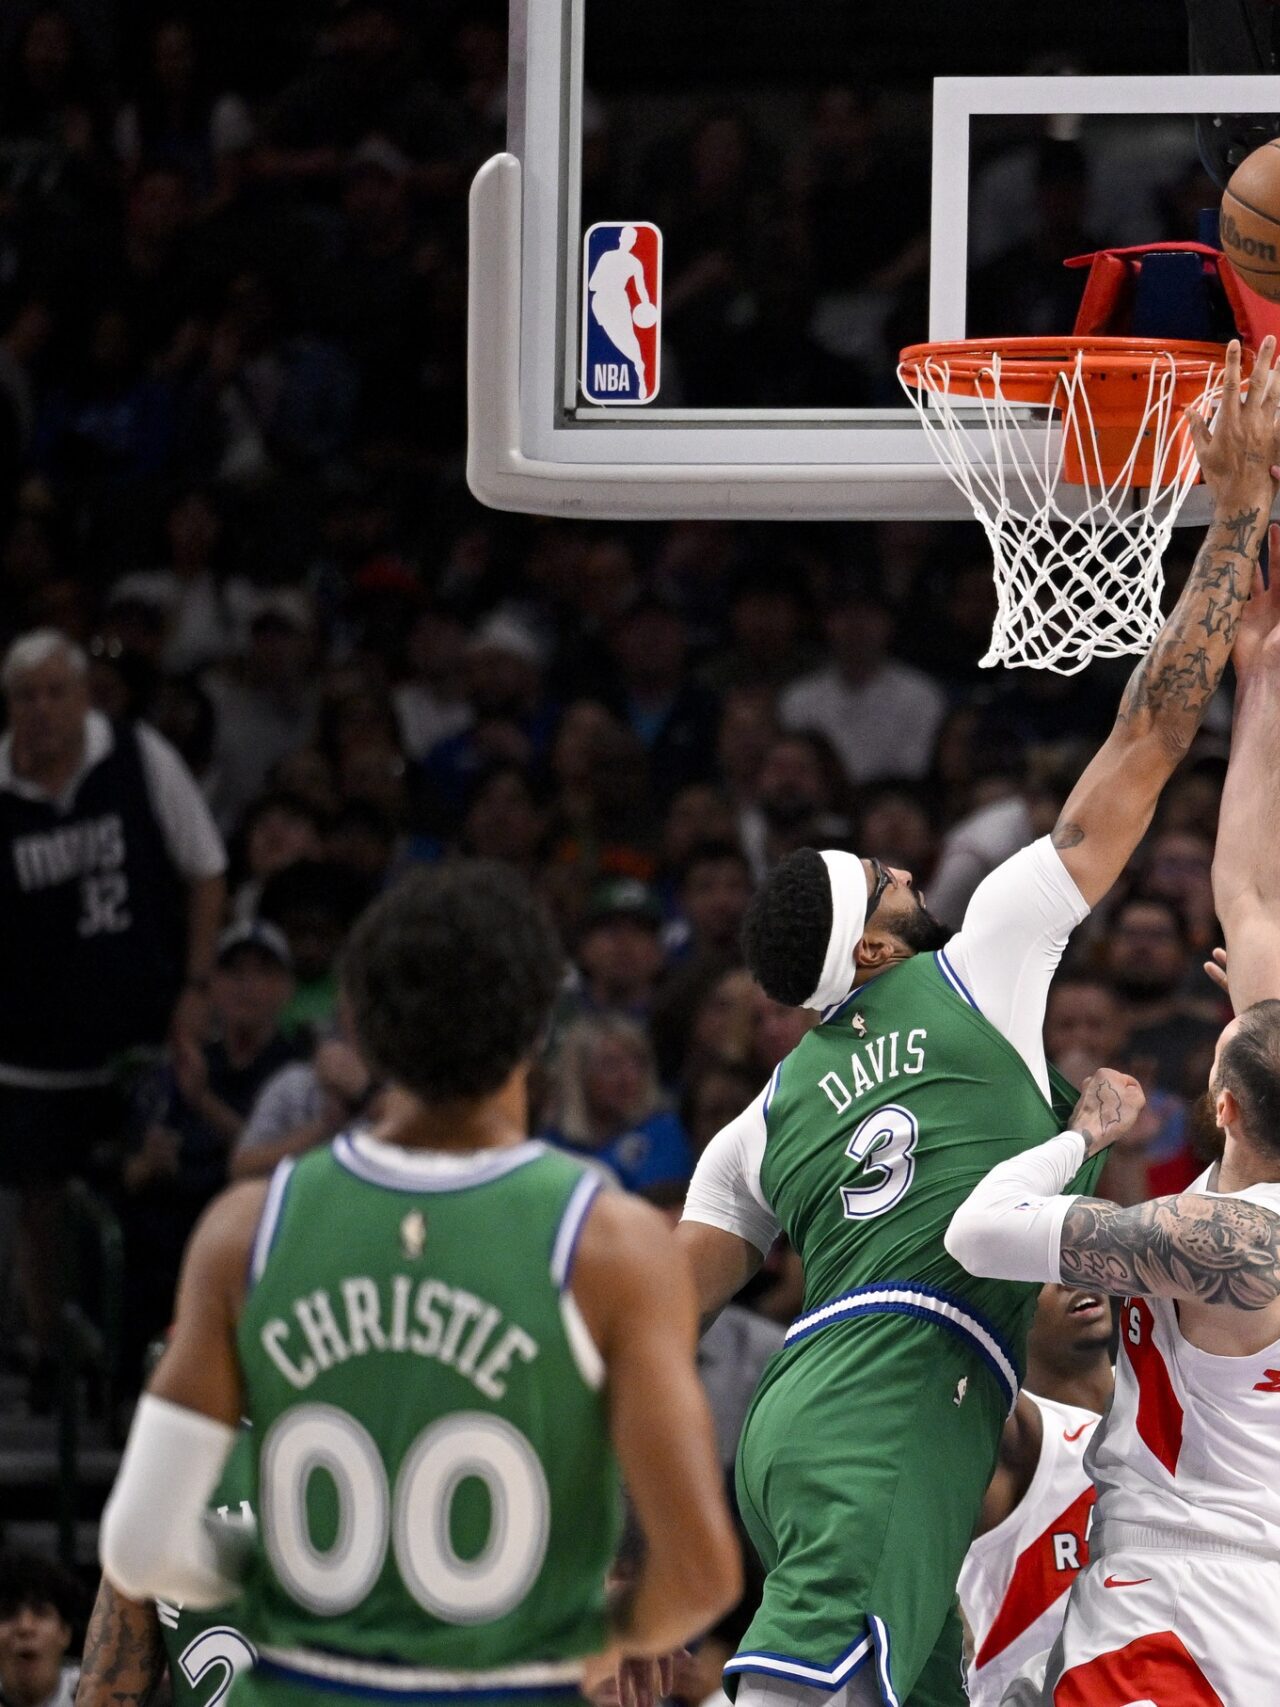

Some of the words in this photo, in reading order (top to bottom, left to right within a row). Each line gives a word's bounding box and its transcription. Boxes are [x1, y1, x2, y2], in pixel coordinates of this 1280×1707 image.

[594, 363, 630, 392] NBA
[817, 1028, 927, 1115] DAVIS
[839, 1103, 919, 1220] 3
[260, 1273, 538, 1400] CHRISTIE
[260, 1401, 551, 1626] 00
